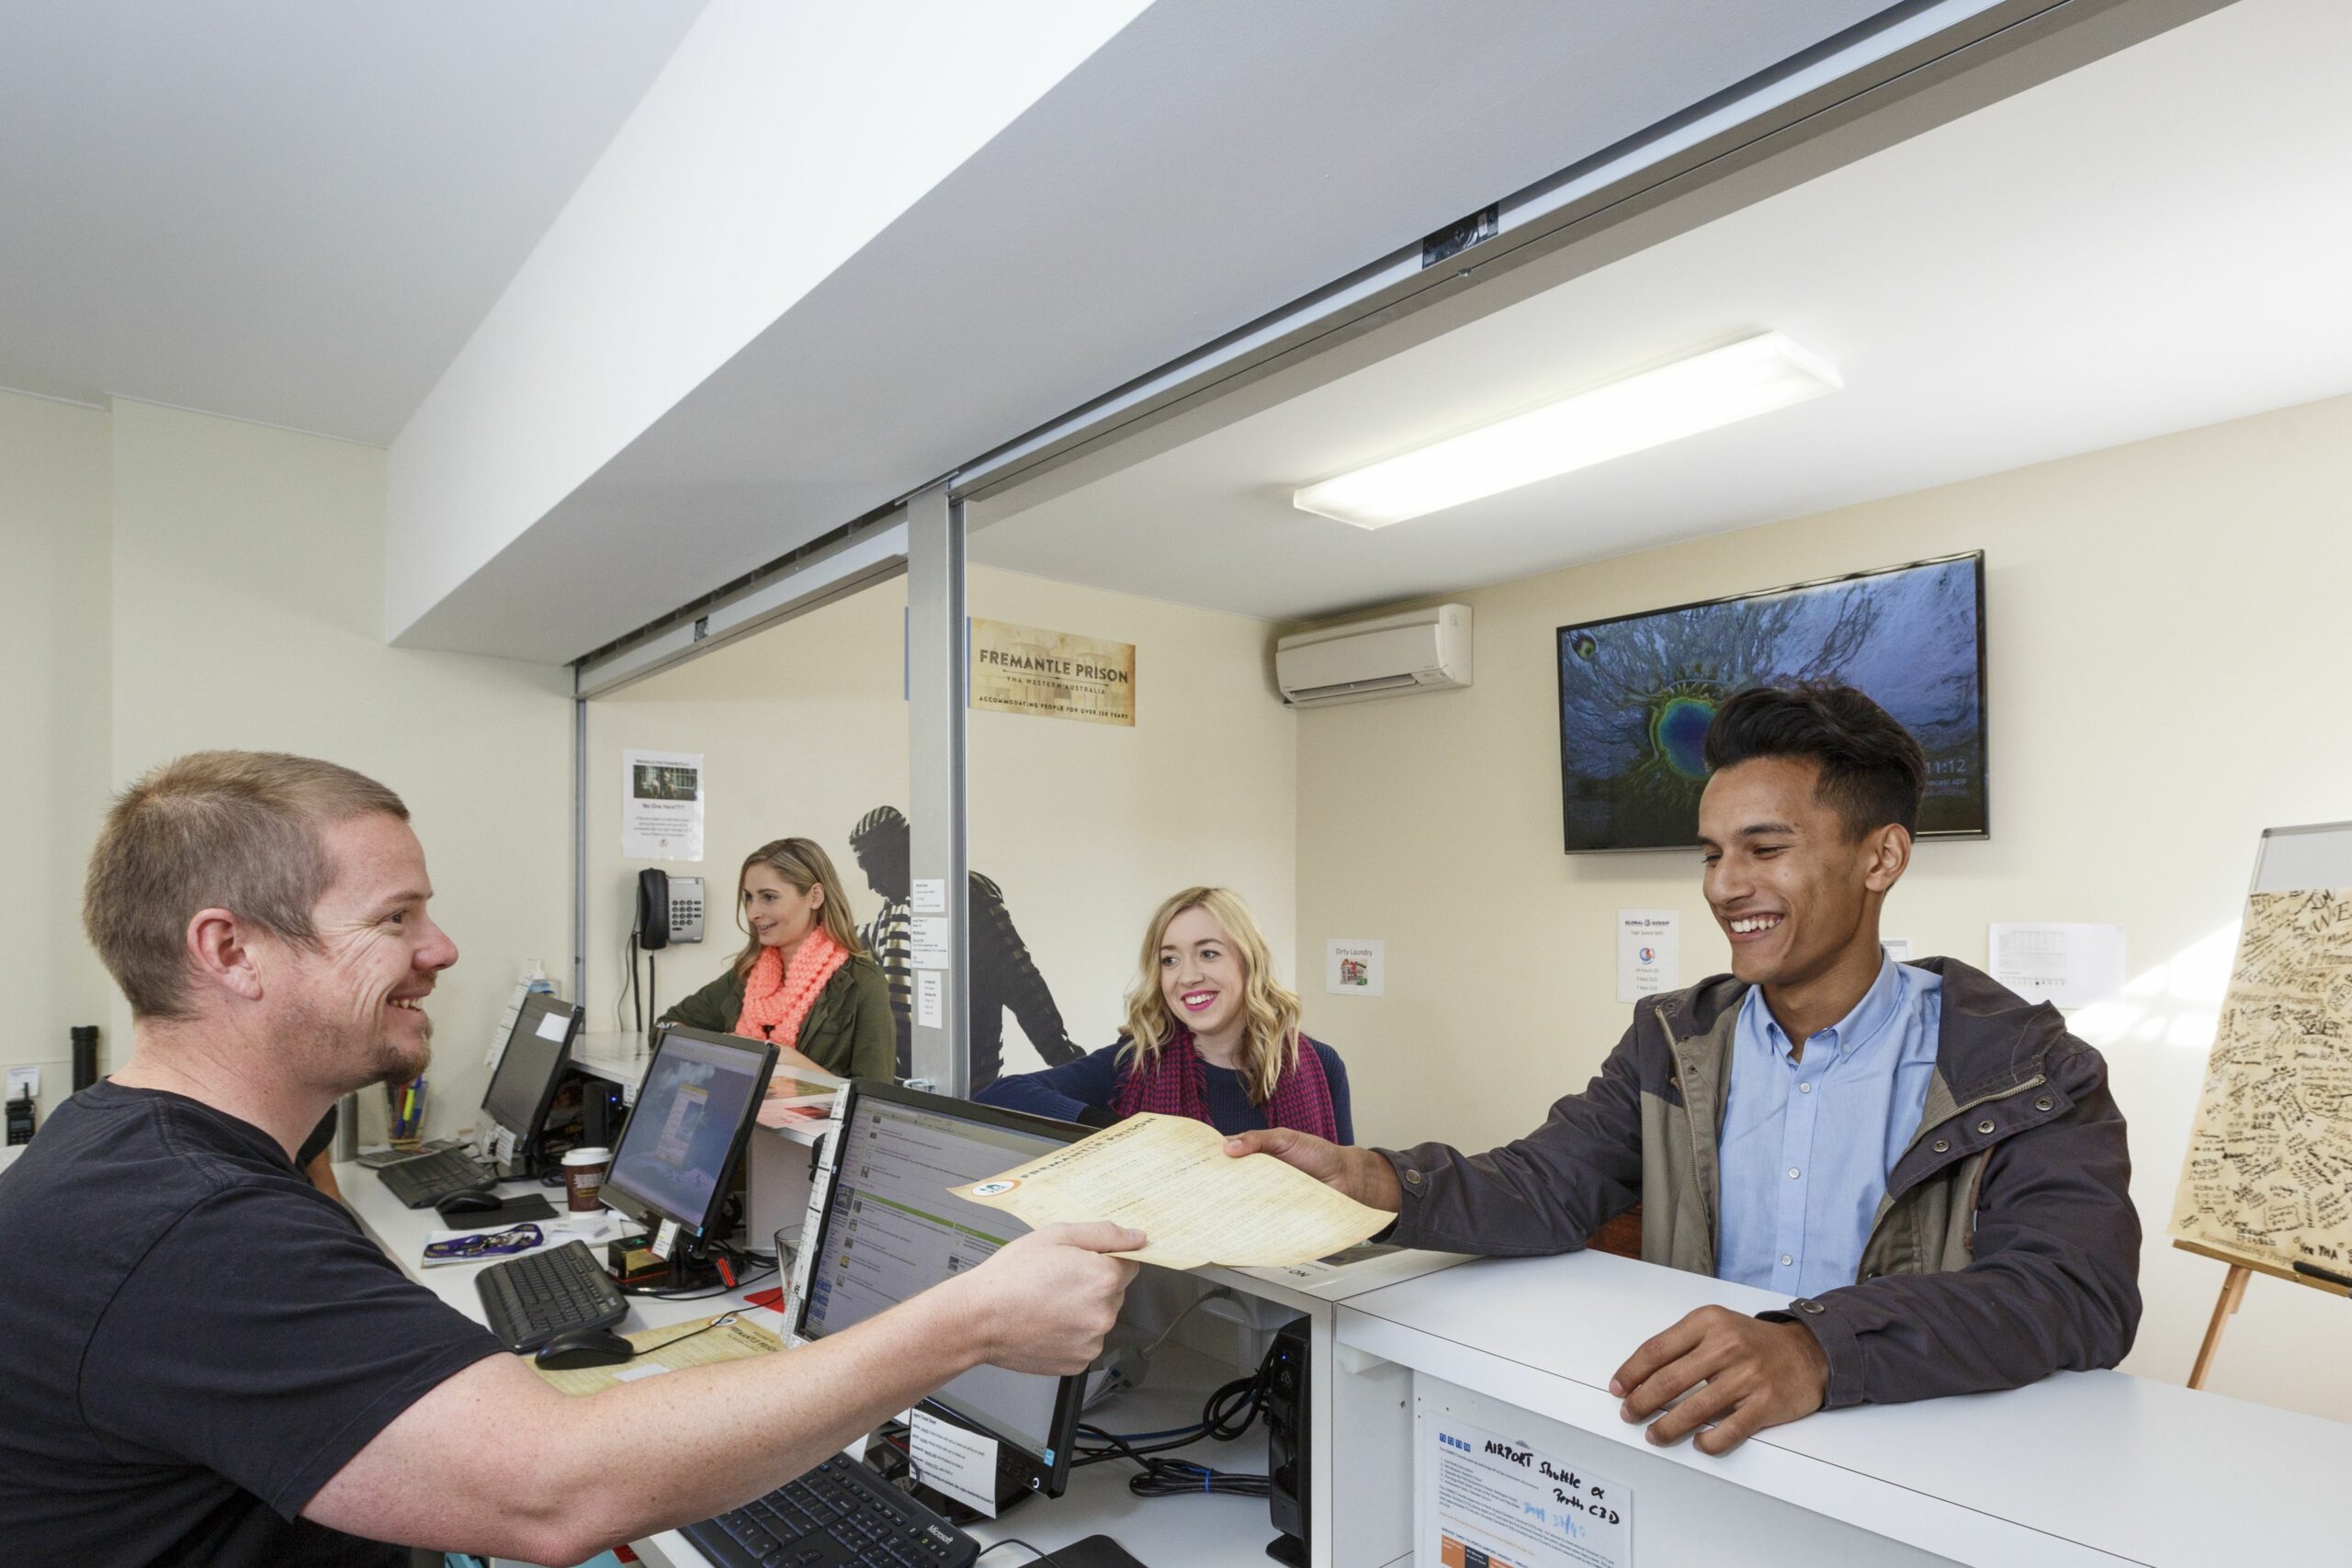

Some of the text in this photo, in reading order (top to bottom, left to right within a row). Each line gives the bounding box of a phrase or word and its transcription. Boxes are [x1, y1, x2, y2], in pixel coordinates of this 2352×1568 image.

[979, 649, 1128, 683] FREMANTLE PRISON
[1026, 678, 1061, 689] WESTERN
[1065, 684, 1105, 694] AUSTRALIA
[978, 696, 1038, 708] ACCOMMODATING
[1041, 703, 1064, 711] PEOPLE
[1335, 947, 1374, 957] Dirty Laundry
[1020, 1141, 1105, 1179] FREMANTLE
[1105, 1117, 1157, 1142] PRISON
[1485, 1440, 1533, 1467] AIRPORT
[1539, 1461, 1581, 1489] Shuttle
[1553, 1488, 1620, 1525] Perth CBD
[926, 1524, 954, 1544] Microsoft
